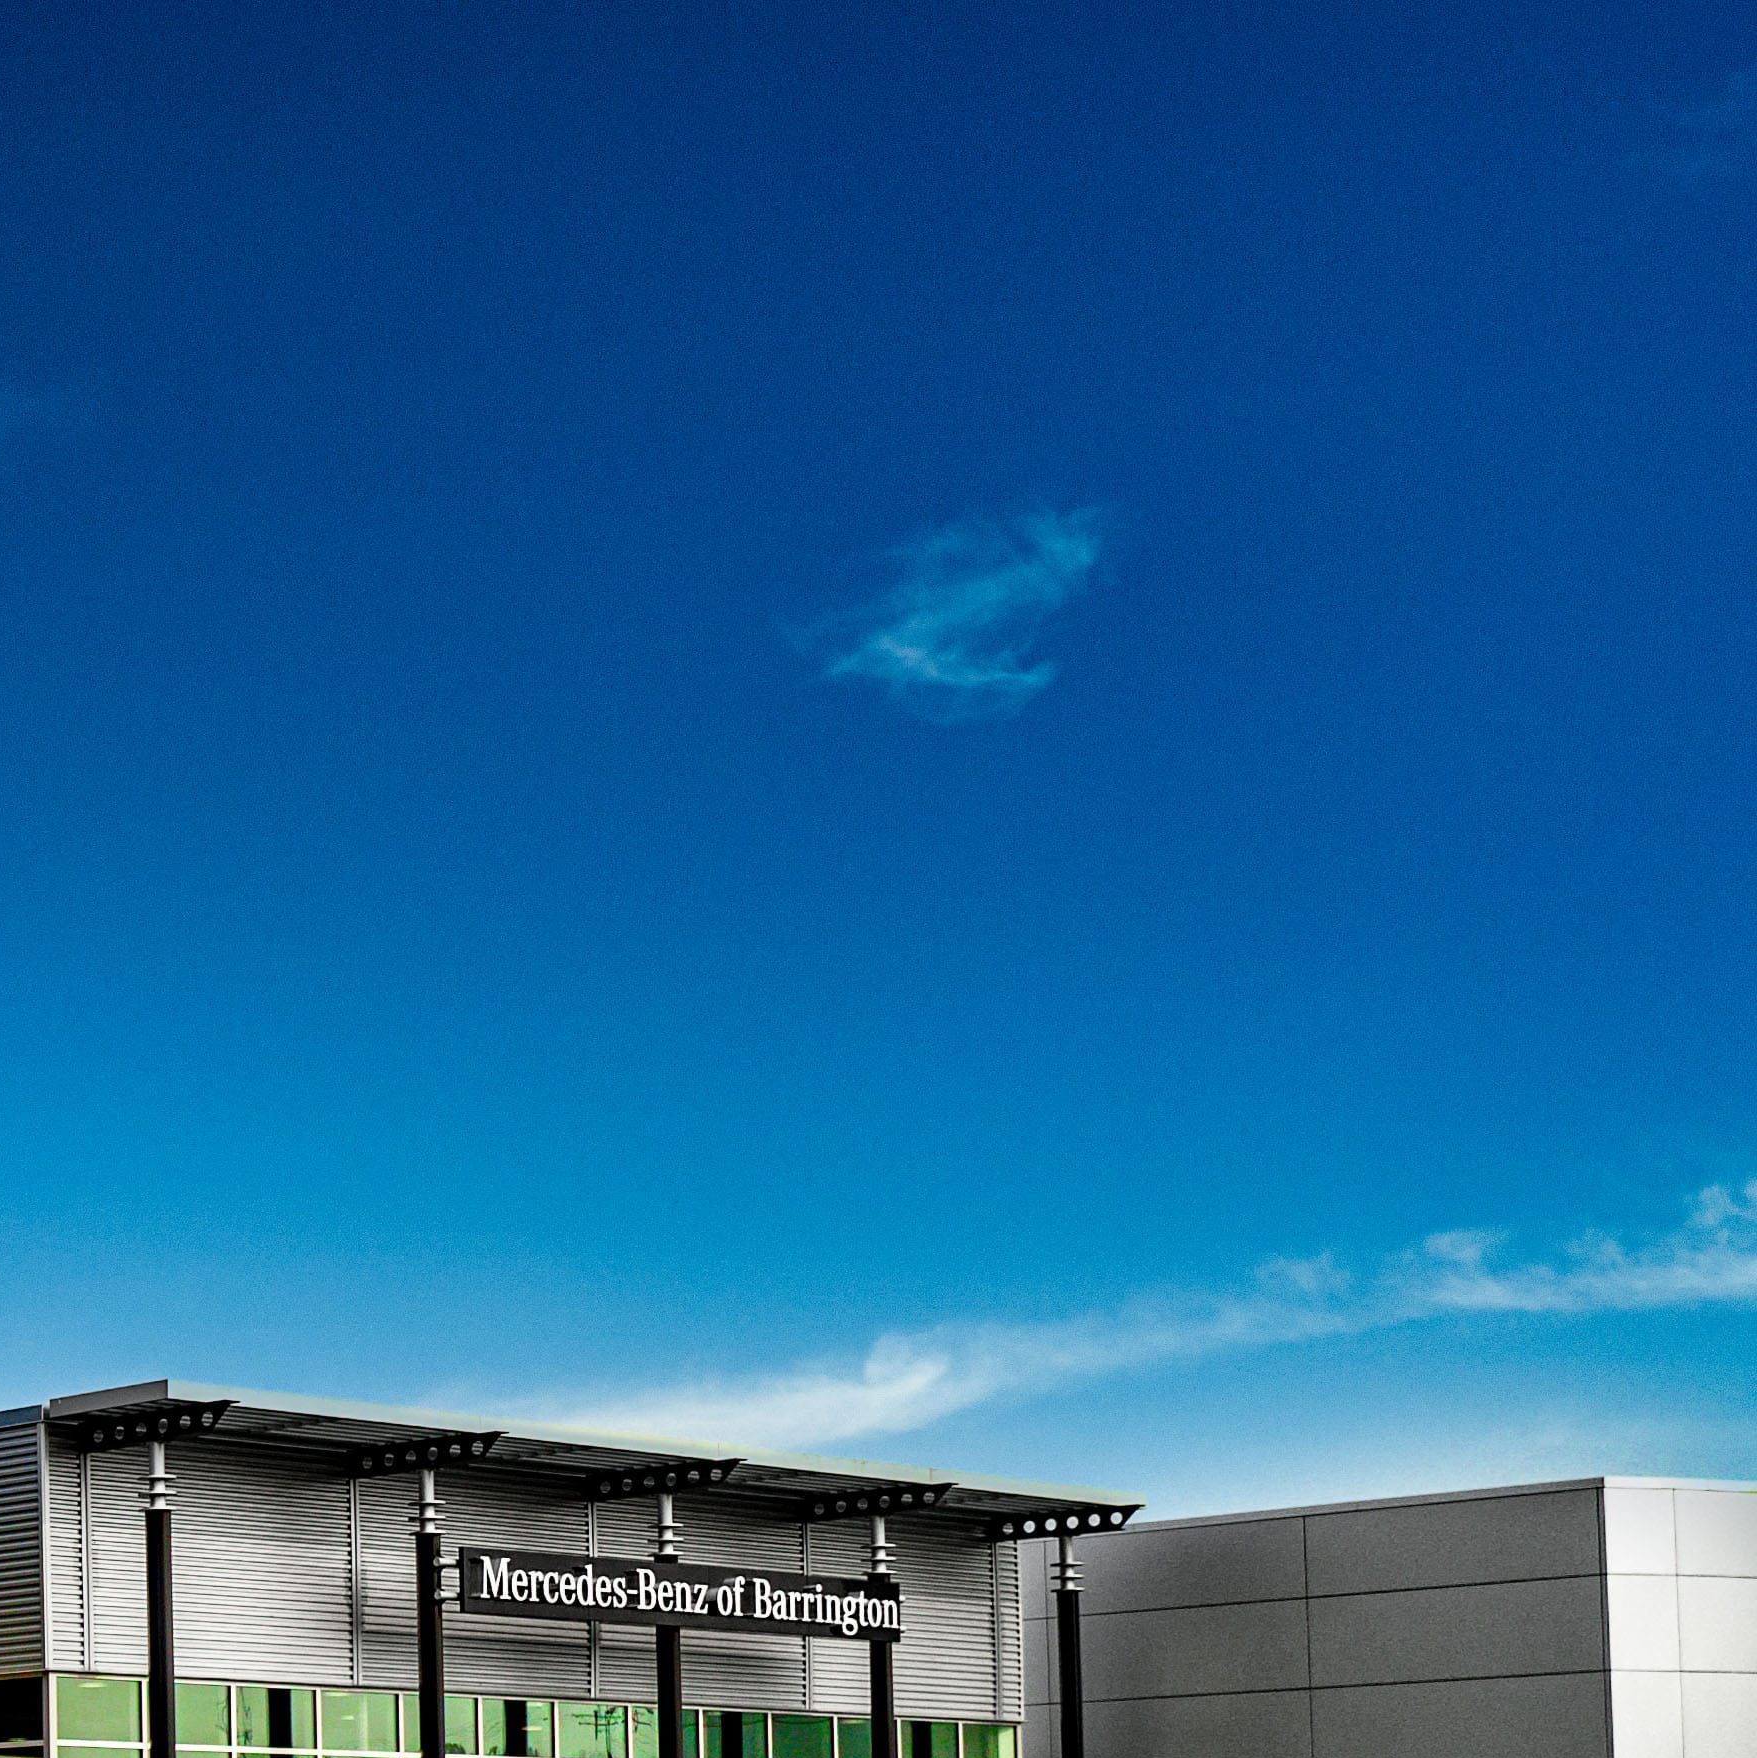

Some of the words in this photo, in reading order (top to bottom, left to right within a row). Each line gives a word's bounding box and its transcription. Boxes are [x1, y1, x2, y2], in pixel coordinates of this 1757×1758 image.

[480, 1556, 709, 1614] Mercedes-Benz
[717, 1576, 746, 1616] of
[753, 1578, 900, 1636] Barrington
